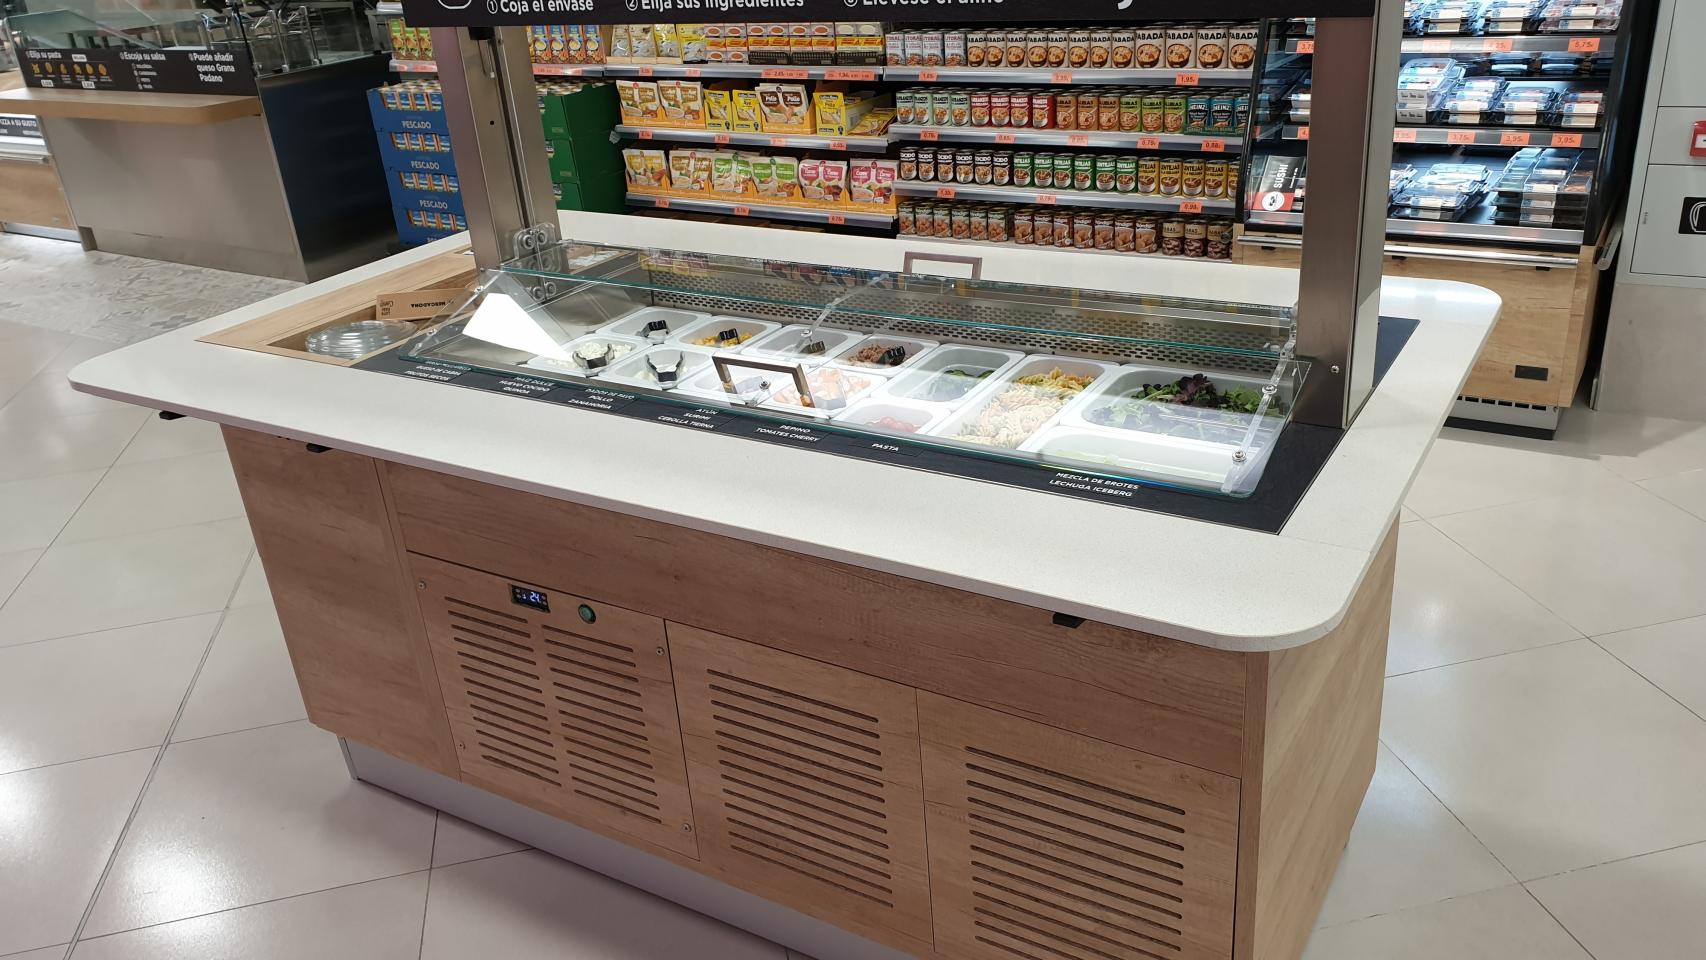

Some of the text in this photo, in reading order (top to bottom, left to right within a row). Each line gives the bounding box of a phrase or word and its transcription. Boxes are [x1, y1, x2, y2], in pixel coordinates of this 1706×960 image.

[500, 0, 529, 15] Coja
[533, 0, 544, 11] el
[548, 0, 595, 12] envase
[642, 0, 672, 12] Elija
[677, 0, 701, 9] sus
[194, 53, 213, 61] Puede
[197, 64, 235, 73] queso Grana
[200, 73, 223, 82] Padano
[402, 120, 432, 130] PESCADO
[411, 160, 440, 171] PESCADO
[1273, 164, 1289, 189] SUSHI
[419, 199, 448, 210] PESCADO
[410, 301, 446, 309] MERCADONA
[683, 412, 711, 420] SURIMI
[657, 415, 714, 429] CEBOLLA TIERNA
[779, 424, 811, 433] PEPINO
[756, 427, 820, 443] TOMATES CHERRY
[871, 443, 899, 452] PASTA
[1055, 472, 1089, 482] MEZCLA
[1104, 479, 1139, 490] BROTES
[1049, 479, 1133, 497] LECHUGA ICEBERG
